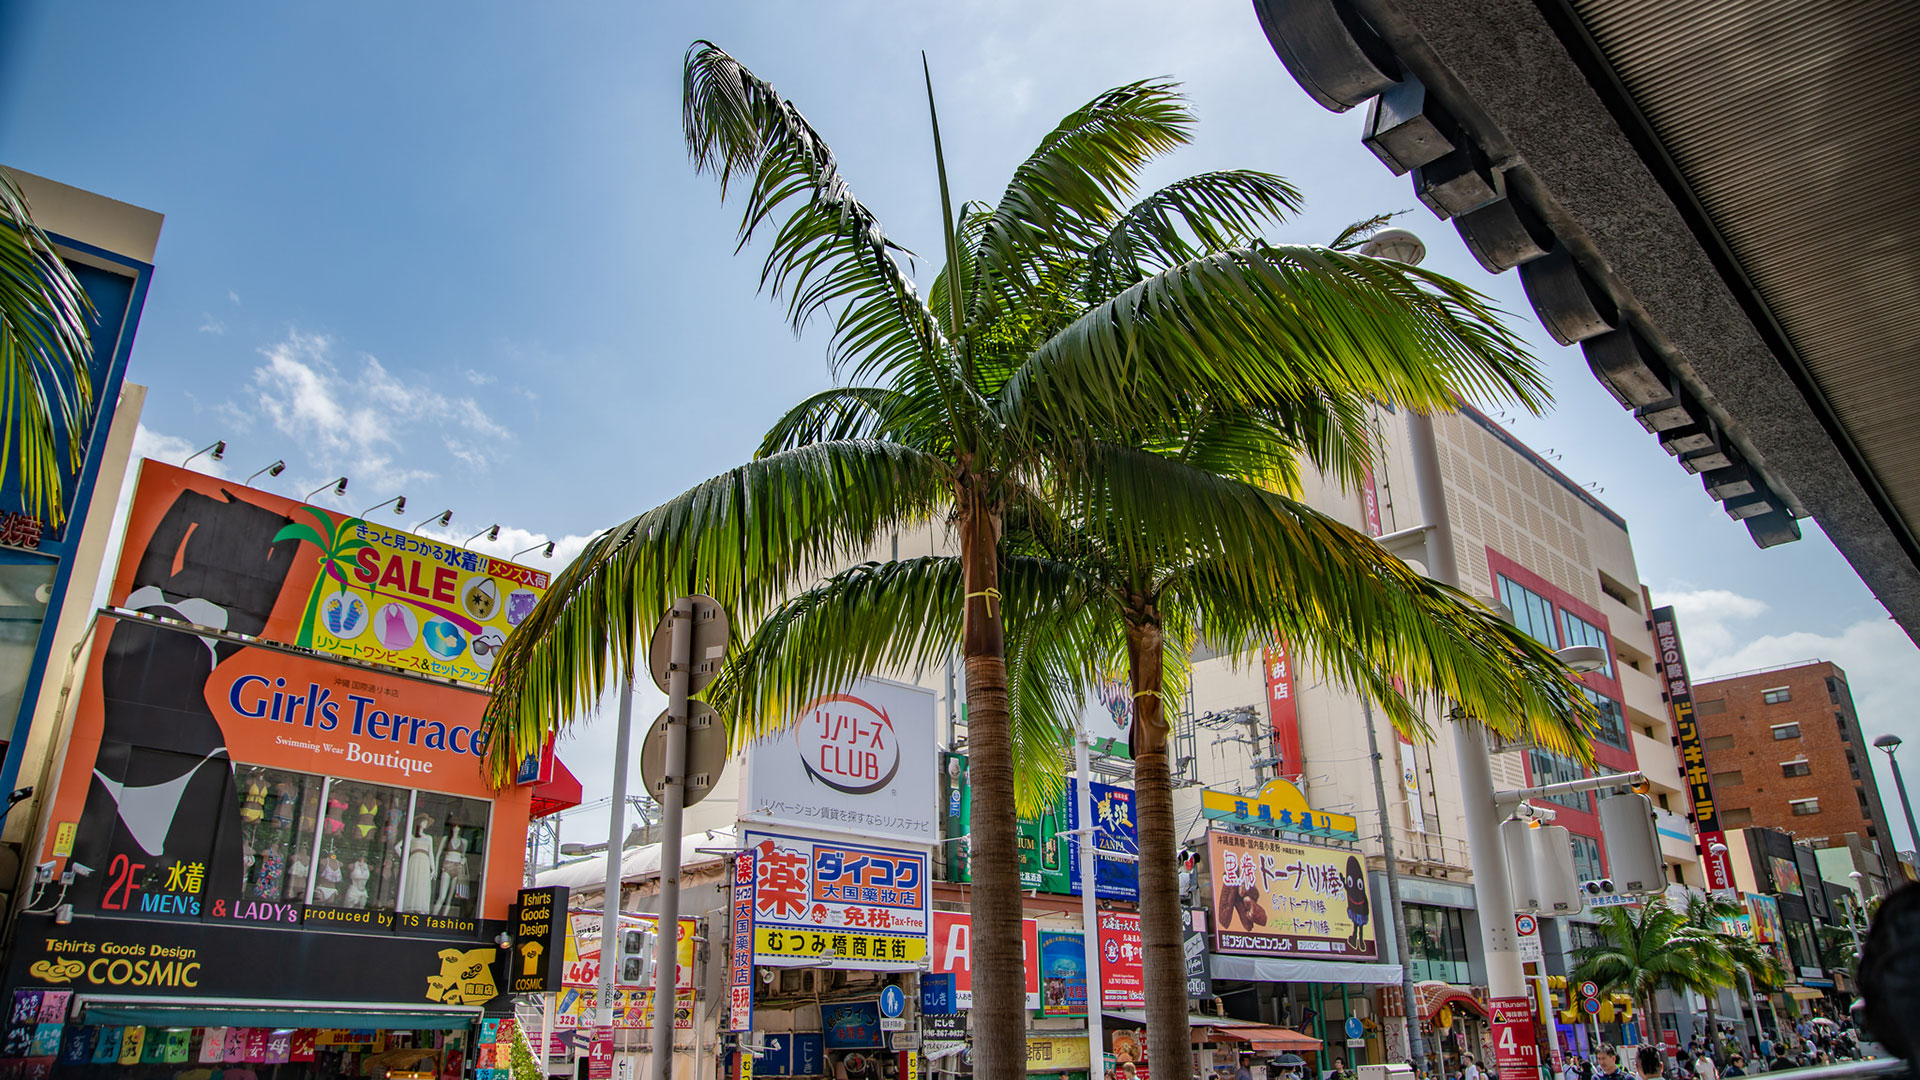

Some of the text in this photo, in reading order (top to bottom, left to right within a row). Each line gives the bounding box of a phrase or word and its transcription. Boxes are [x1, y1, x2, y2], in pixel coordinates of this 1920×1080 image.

[354, 546, 458, 605] SALE
[490, 561, 548, 590] メンズ入荷
[229, 674, 489, 757] Girl's Terrace
[815, 710, 885, 750] リノリース
[275, 735, 433, 777] Swimming Wear Boutique
[820, 744, 879, 780] CLUB
[1234, 800, 1332, 834] 市場本通り
[1099, 838, 1125, 851] ZANPA
[101, 853, 146, 911] 2F
[164, 860, 205, 894] 水着
[736, 853, 754, 884] 薬
[757, 840, 807, 916] 薬
[816, 851, 920, 890] ダイコク
[1711, 860, 1724, 885] Free
[140, 892, 474, 932] MEN's & LADY's produced by TS fashion
[520, 906, 550, 922] Goods
[522, 892, 551, 907] Tshirts
[519, 923, 549, 937] Design
[843, 905, 923, 929] 免税 Tax-Free
[45, 938, 196, 959] Tshirts Goods Design
[767, 931, 906, 959] むつみ橋商店街
[88, 957, 201, 988] COSMIC
[515, 977, 543, 991] COSMIC
[732, 987, 749, 1008] 免税
[924, 991, 947, 1006] にしき
[592, 1043, 602, 1060] 4
[1499, 1026, 1534, 1056] 4 m
